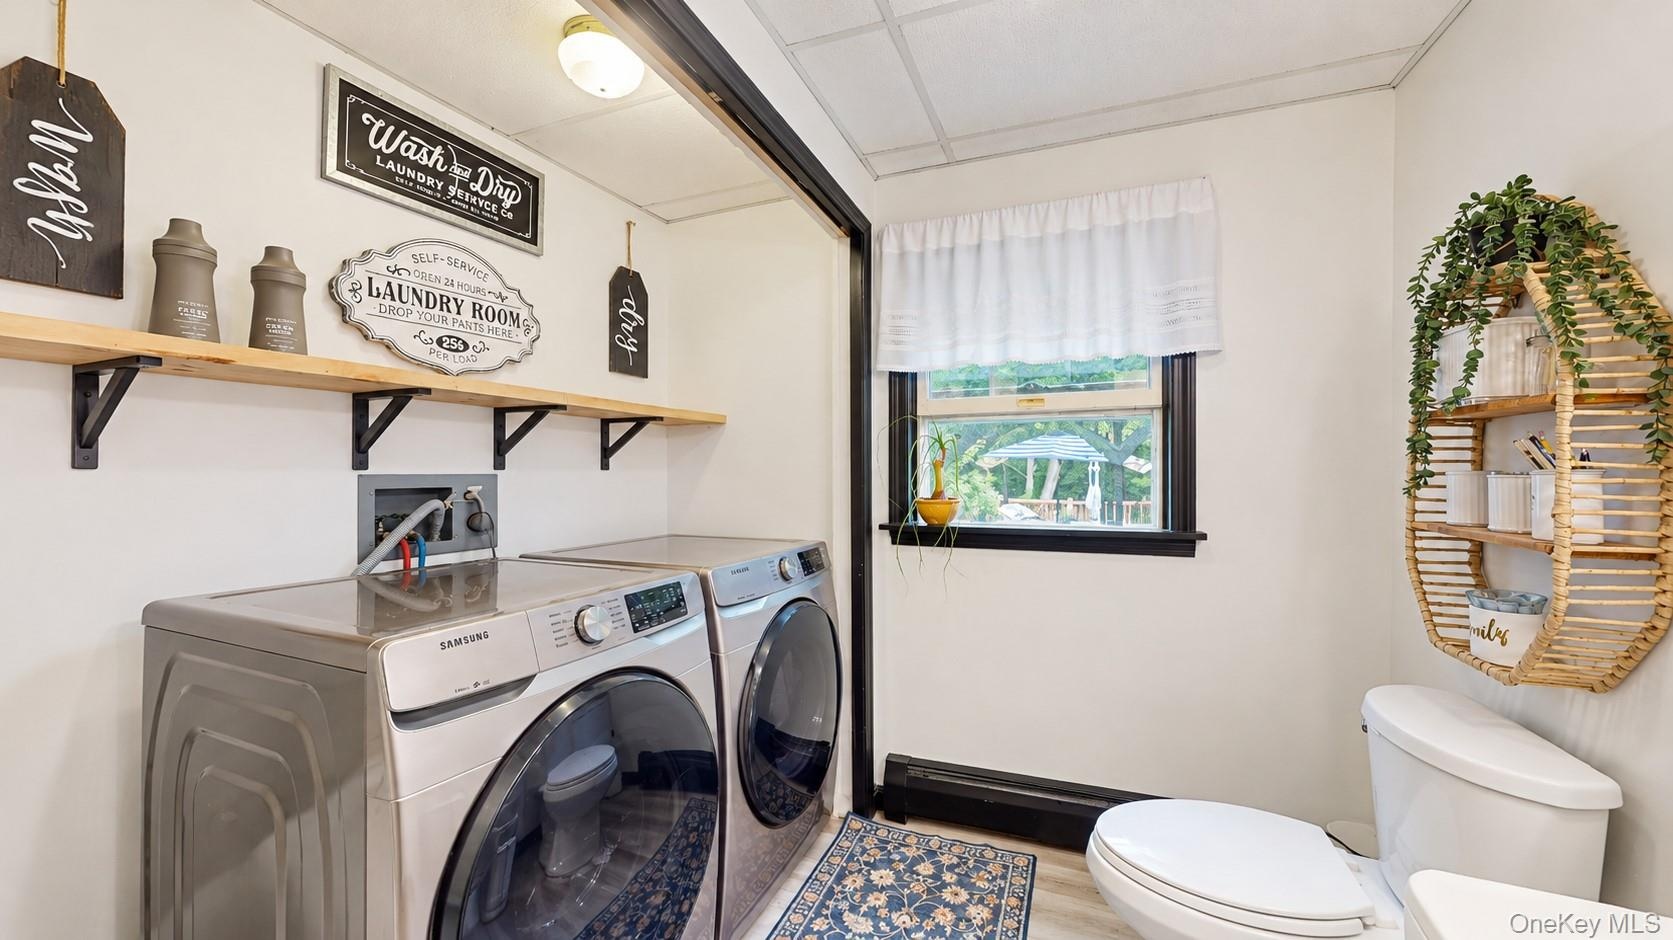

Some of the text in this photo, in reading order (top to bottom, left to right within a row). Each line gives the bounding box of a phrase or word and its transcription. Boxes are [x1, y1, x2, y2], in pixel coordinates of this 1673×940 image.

[361, 112, 447, 172] Wash
[469, 166, 521, 209] Dry
[376, 155, 444, 190] LAUNDRY
[411, 252, 490, 283] SELF-SERVICE
[367, 276, 520, 329] LAUNDRY ROOM
[457, 281, 487, 297] HOURS
[378, 303, 513, 339] DROP YOUR PANTS HERE
[429, 347, 449, 362] PER
[440, 631, 489, 650] SAMSUNG
